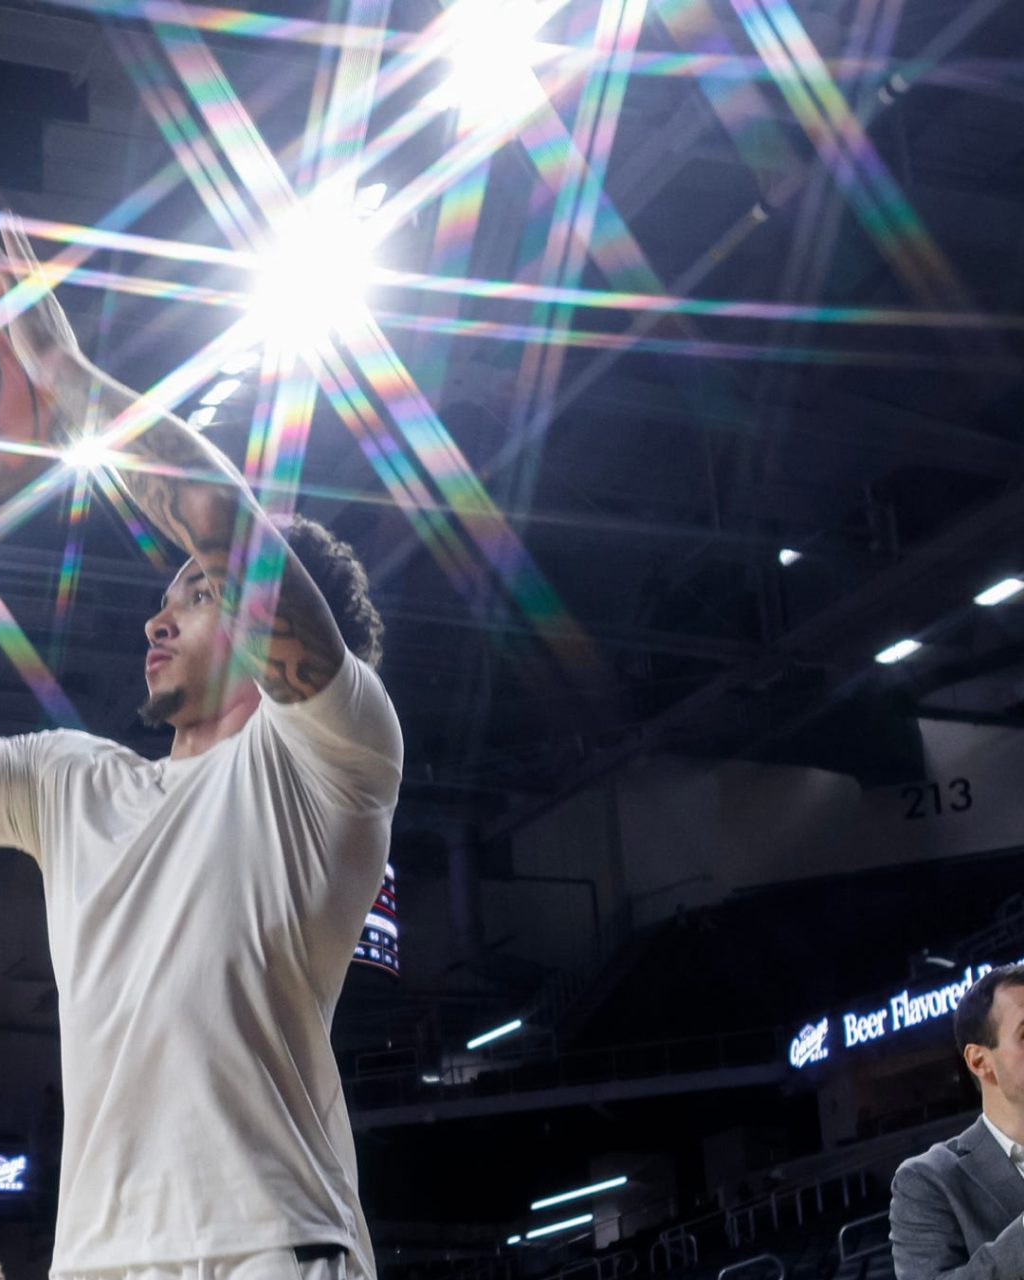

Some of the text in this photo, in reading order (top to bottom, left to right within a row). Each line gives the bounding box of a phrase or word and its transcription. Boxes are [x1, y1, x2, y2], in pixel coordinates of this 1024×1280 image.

[901, 778, 972, 819] 213
[843, 966, 973, 1047] Beer Flavored
